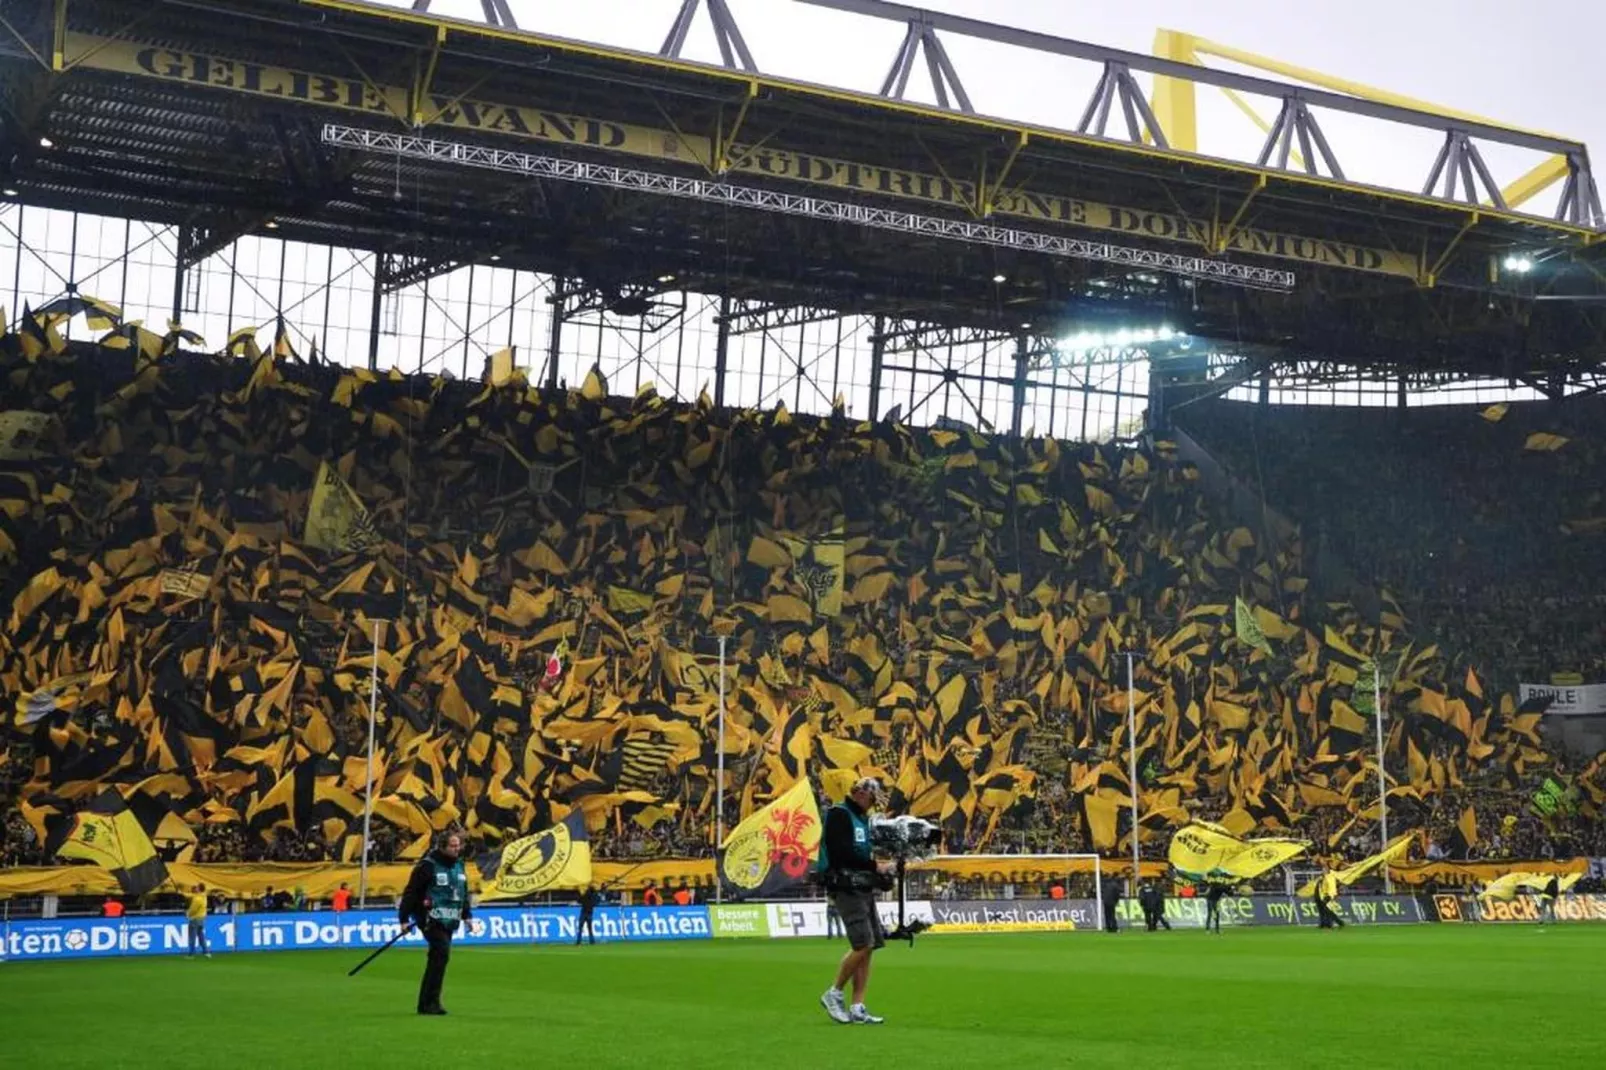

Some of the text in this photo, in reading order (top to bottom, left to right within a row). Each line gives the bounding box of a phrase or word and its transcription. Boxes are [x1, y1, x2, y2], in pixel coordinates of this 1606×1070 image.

[137, 49, 1383, 269] GELBE WAND SÜDTRIBNE DORMUND
[717, 908, 760, 920] Bessere
[937, 907, 979, 925] Your
[984, 906, 1019, 923] best
[1266, 899, 1406, 924] my ste. my tv.
[1482, 893, 1539, 920] Jack
[91, 923, 151, 951] Die
[164, 923, 212, 949] N.
[219, 921, 236, 947] 1
[252, 920, 284, 946] in
[489, 913, 551, 939] Ruhr
